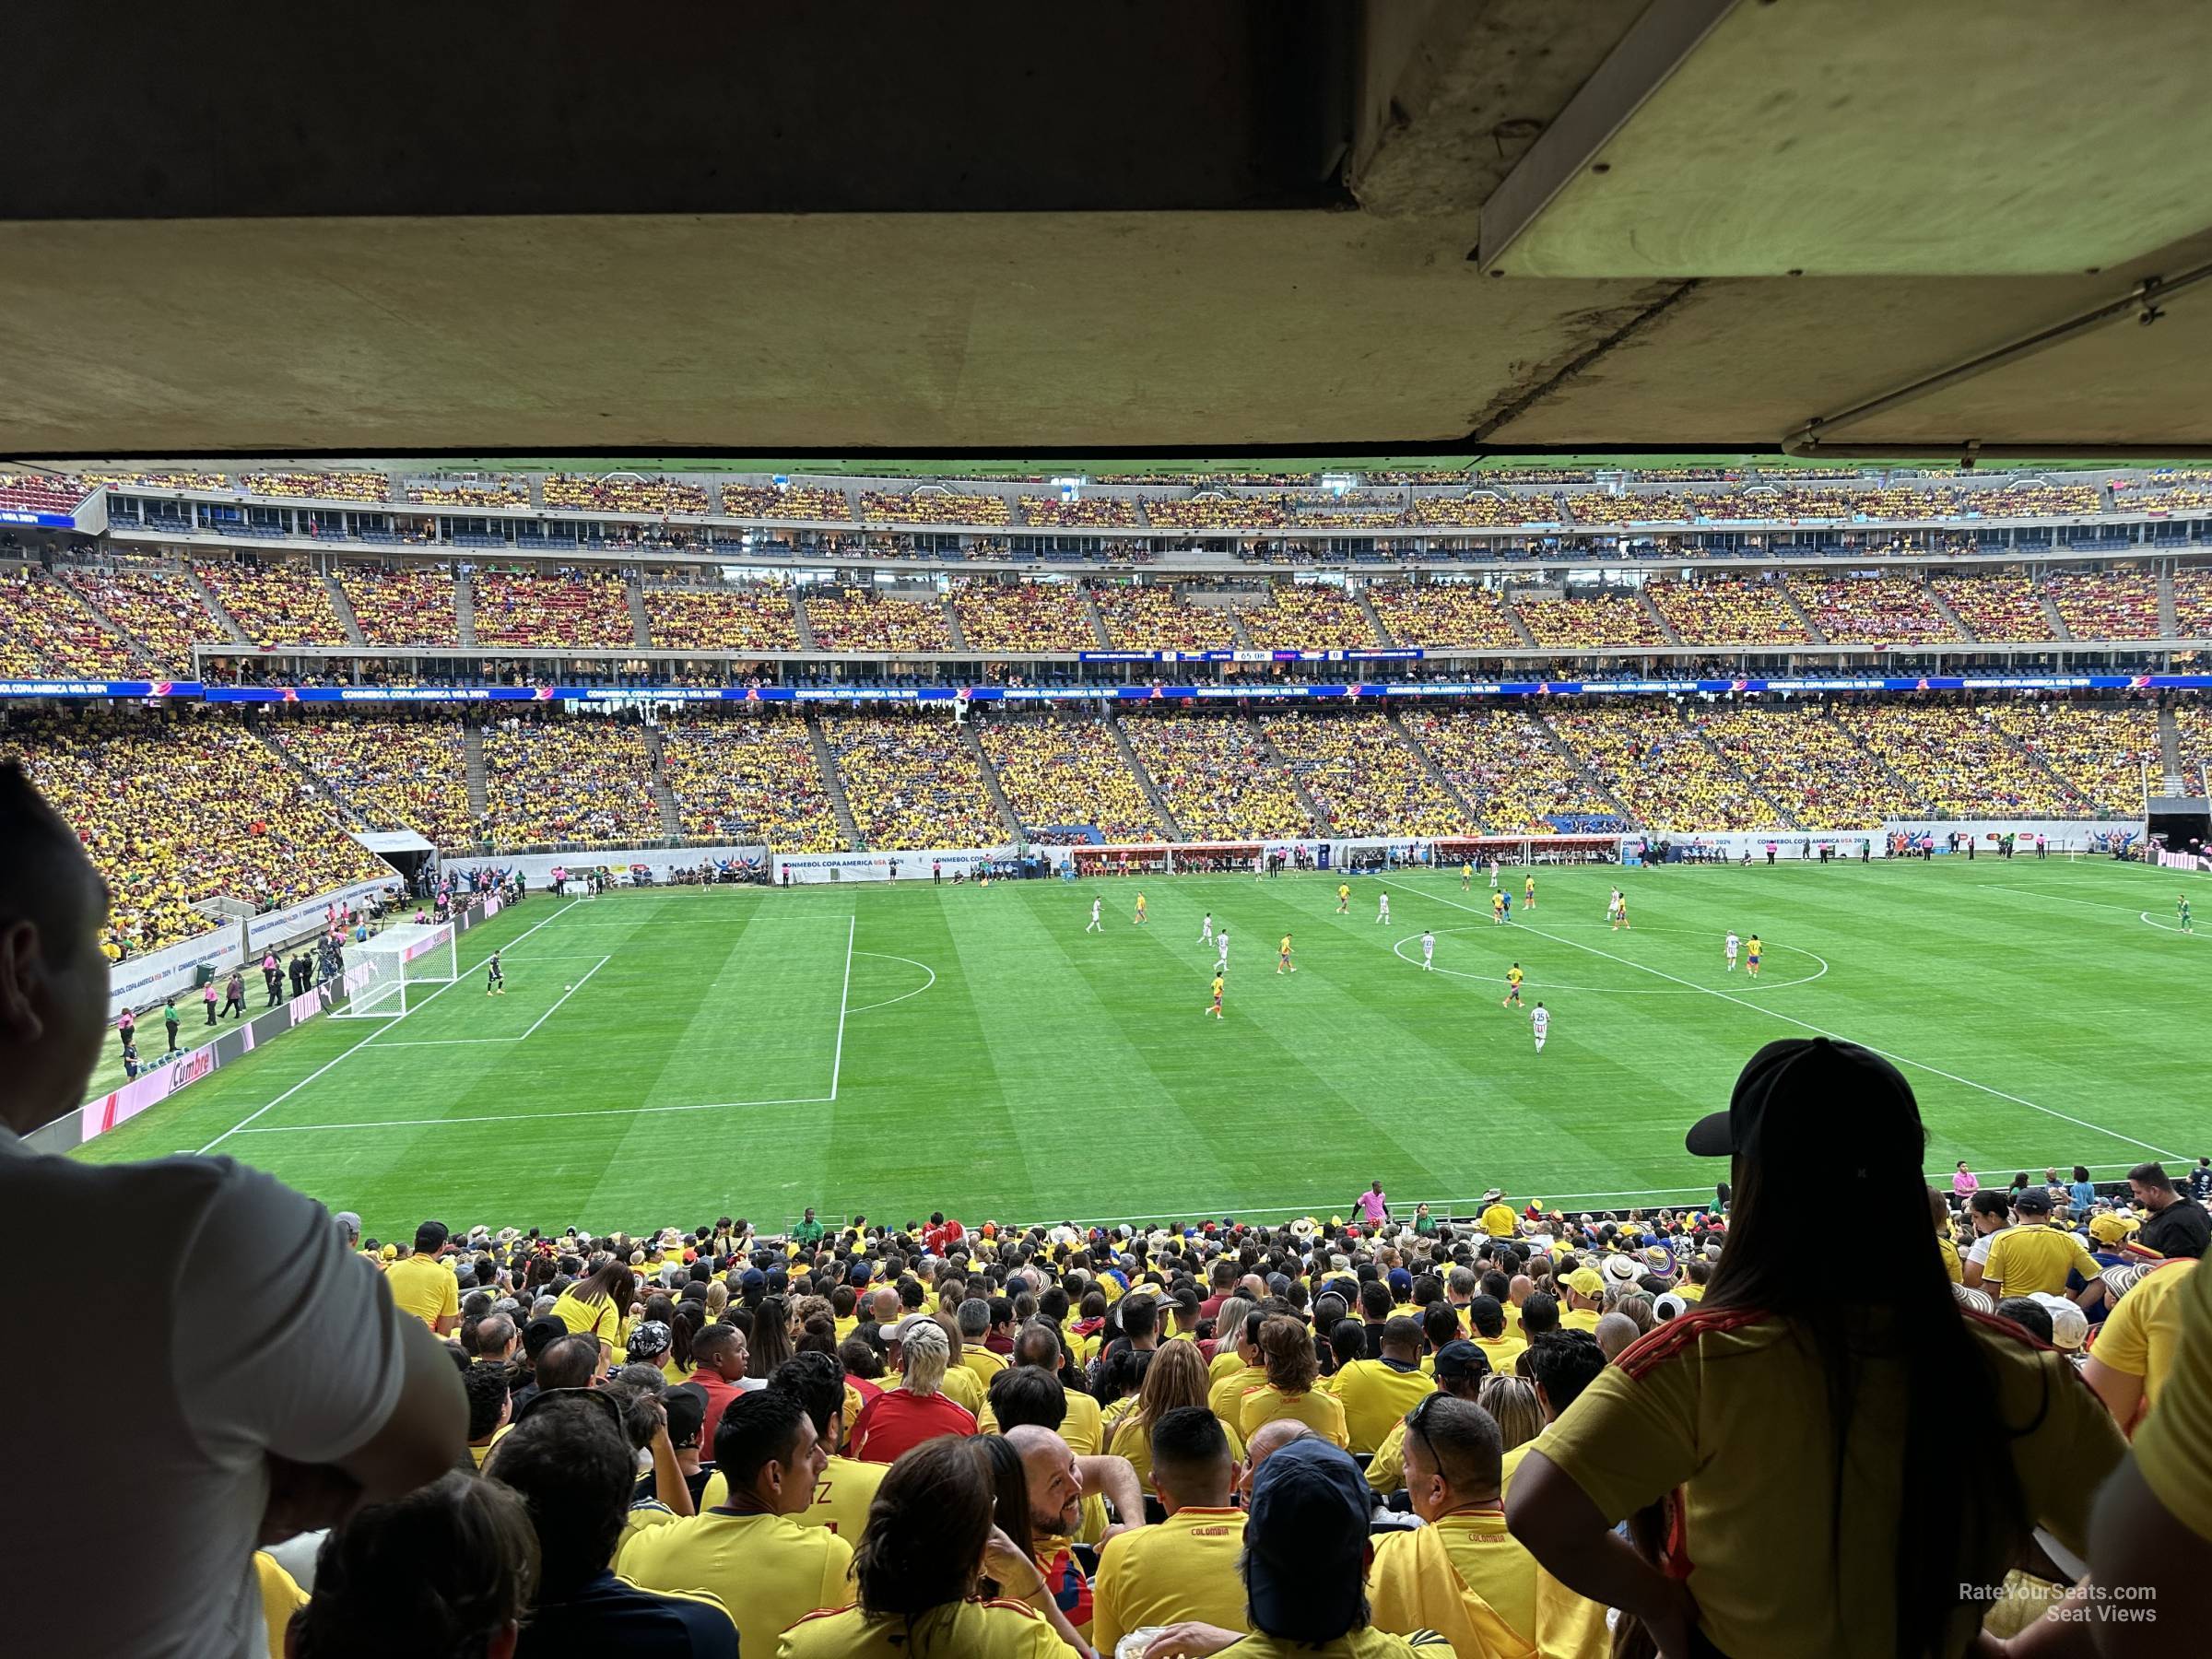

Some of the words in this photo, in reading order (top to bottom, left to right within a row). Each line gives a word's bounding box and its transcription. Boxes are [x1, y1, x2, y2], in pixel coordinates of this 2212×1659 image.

[2158, 852, 2198, 871] PUMA
[178, 960, 197, 972] CONMEBOL
[198, 956, 206, 965] COPA
[207, 950, 221, 960] AMERICA
[110, 988, 126, 997] MEBOL
[126, 983, 137, 992] COPA
[136, 976, 154, 988] AMERICA
[162, 970, 171, 979] 2024
[290, 987, 322, 1027] PUMA
[1537, 1013, 1544, 1022] 25
[1191, 1527, 1229, 1536] COLOMBIA
[1469, 1534, 1506, 1542] COLOMBIA
